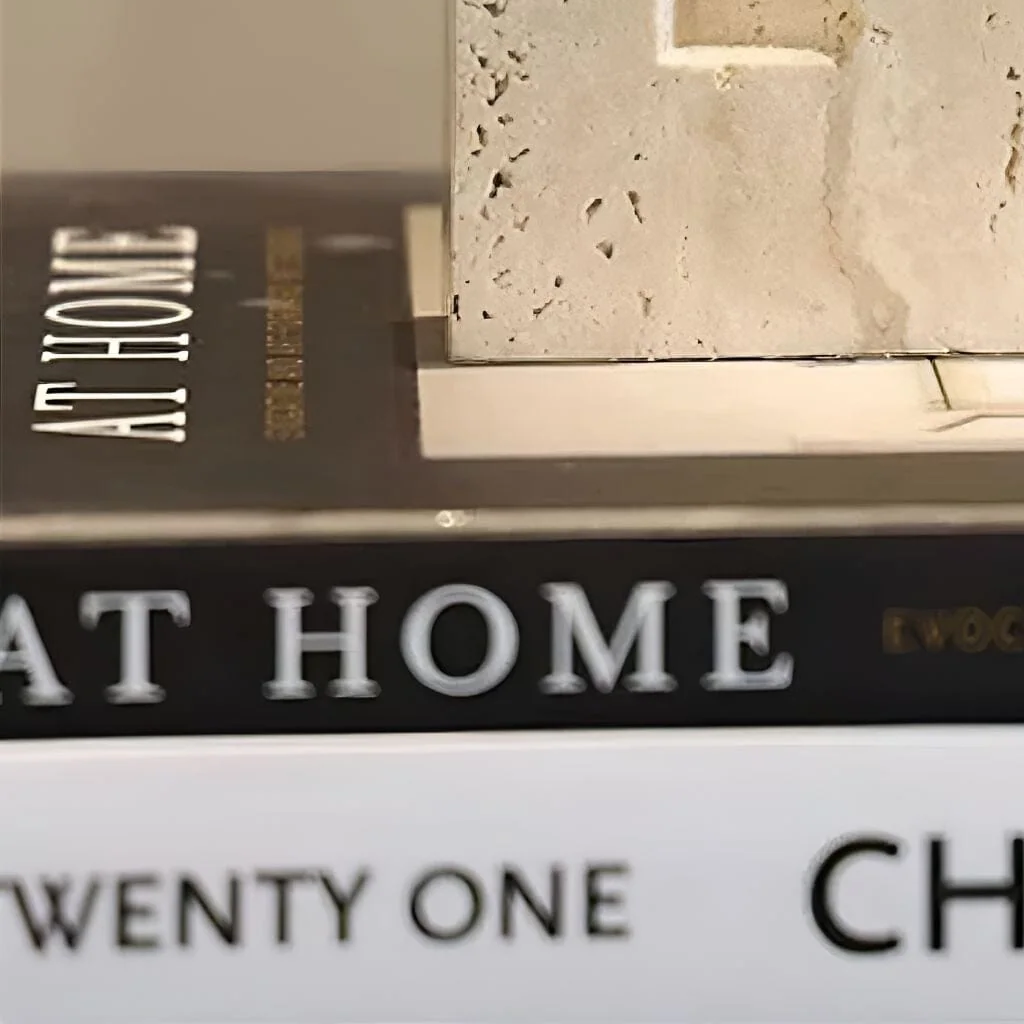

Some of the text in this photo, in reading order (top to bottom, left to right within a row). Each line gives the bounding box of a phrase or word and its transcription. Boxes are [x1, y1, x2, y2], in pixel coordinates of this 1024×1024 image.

[31, 225, 199, 443] AT HOME
[0, 578, 796, 707] AT HOME
[406, 862, 632, 947] ONE
